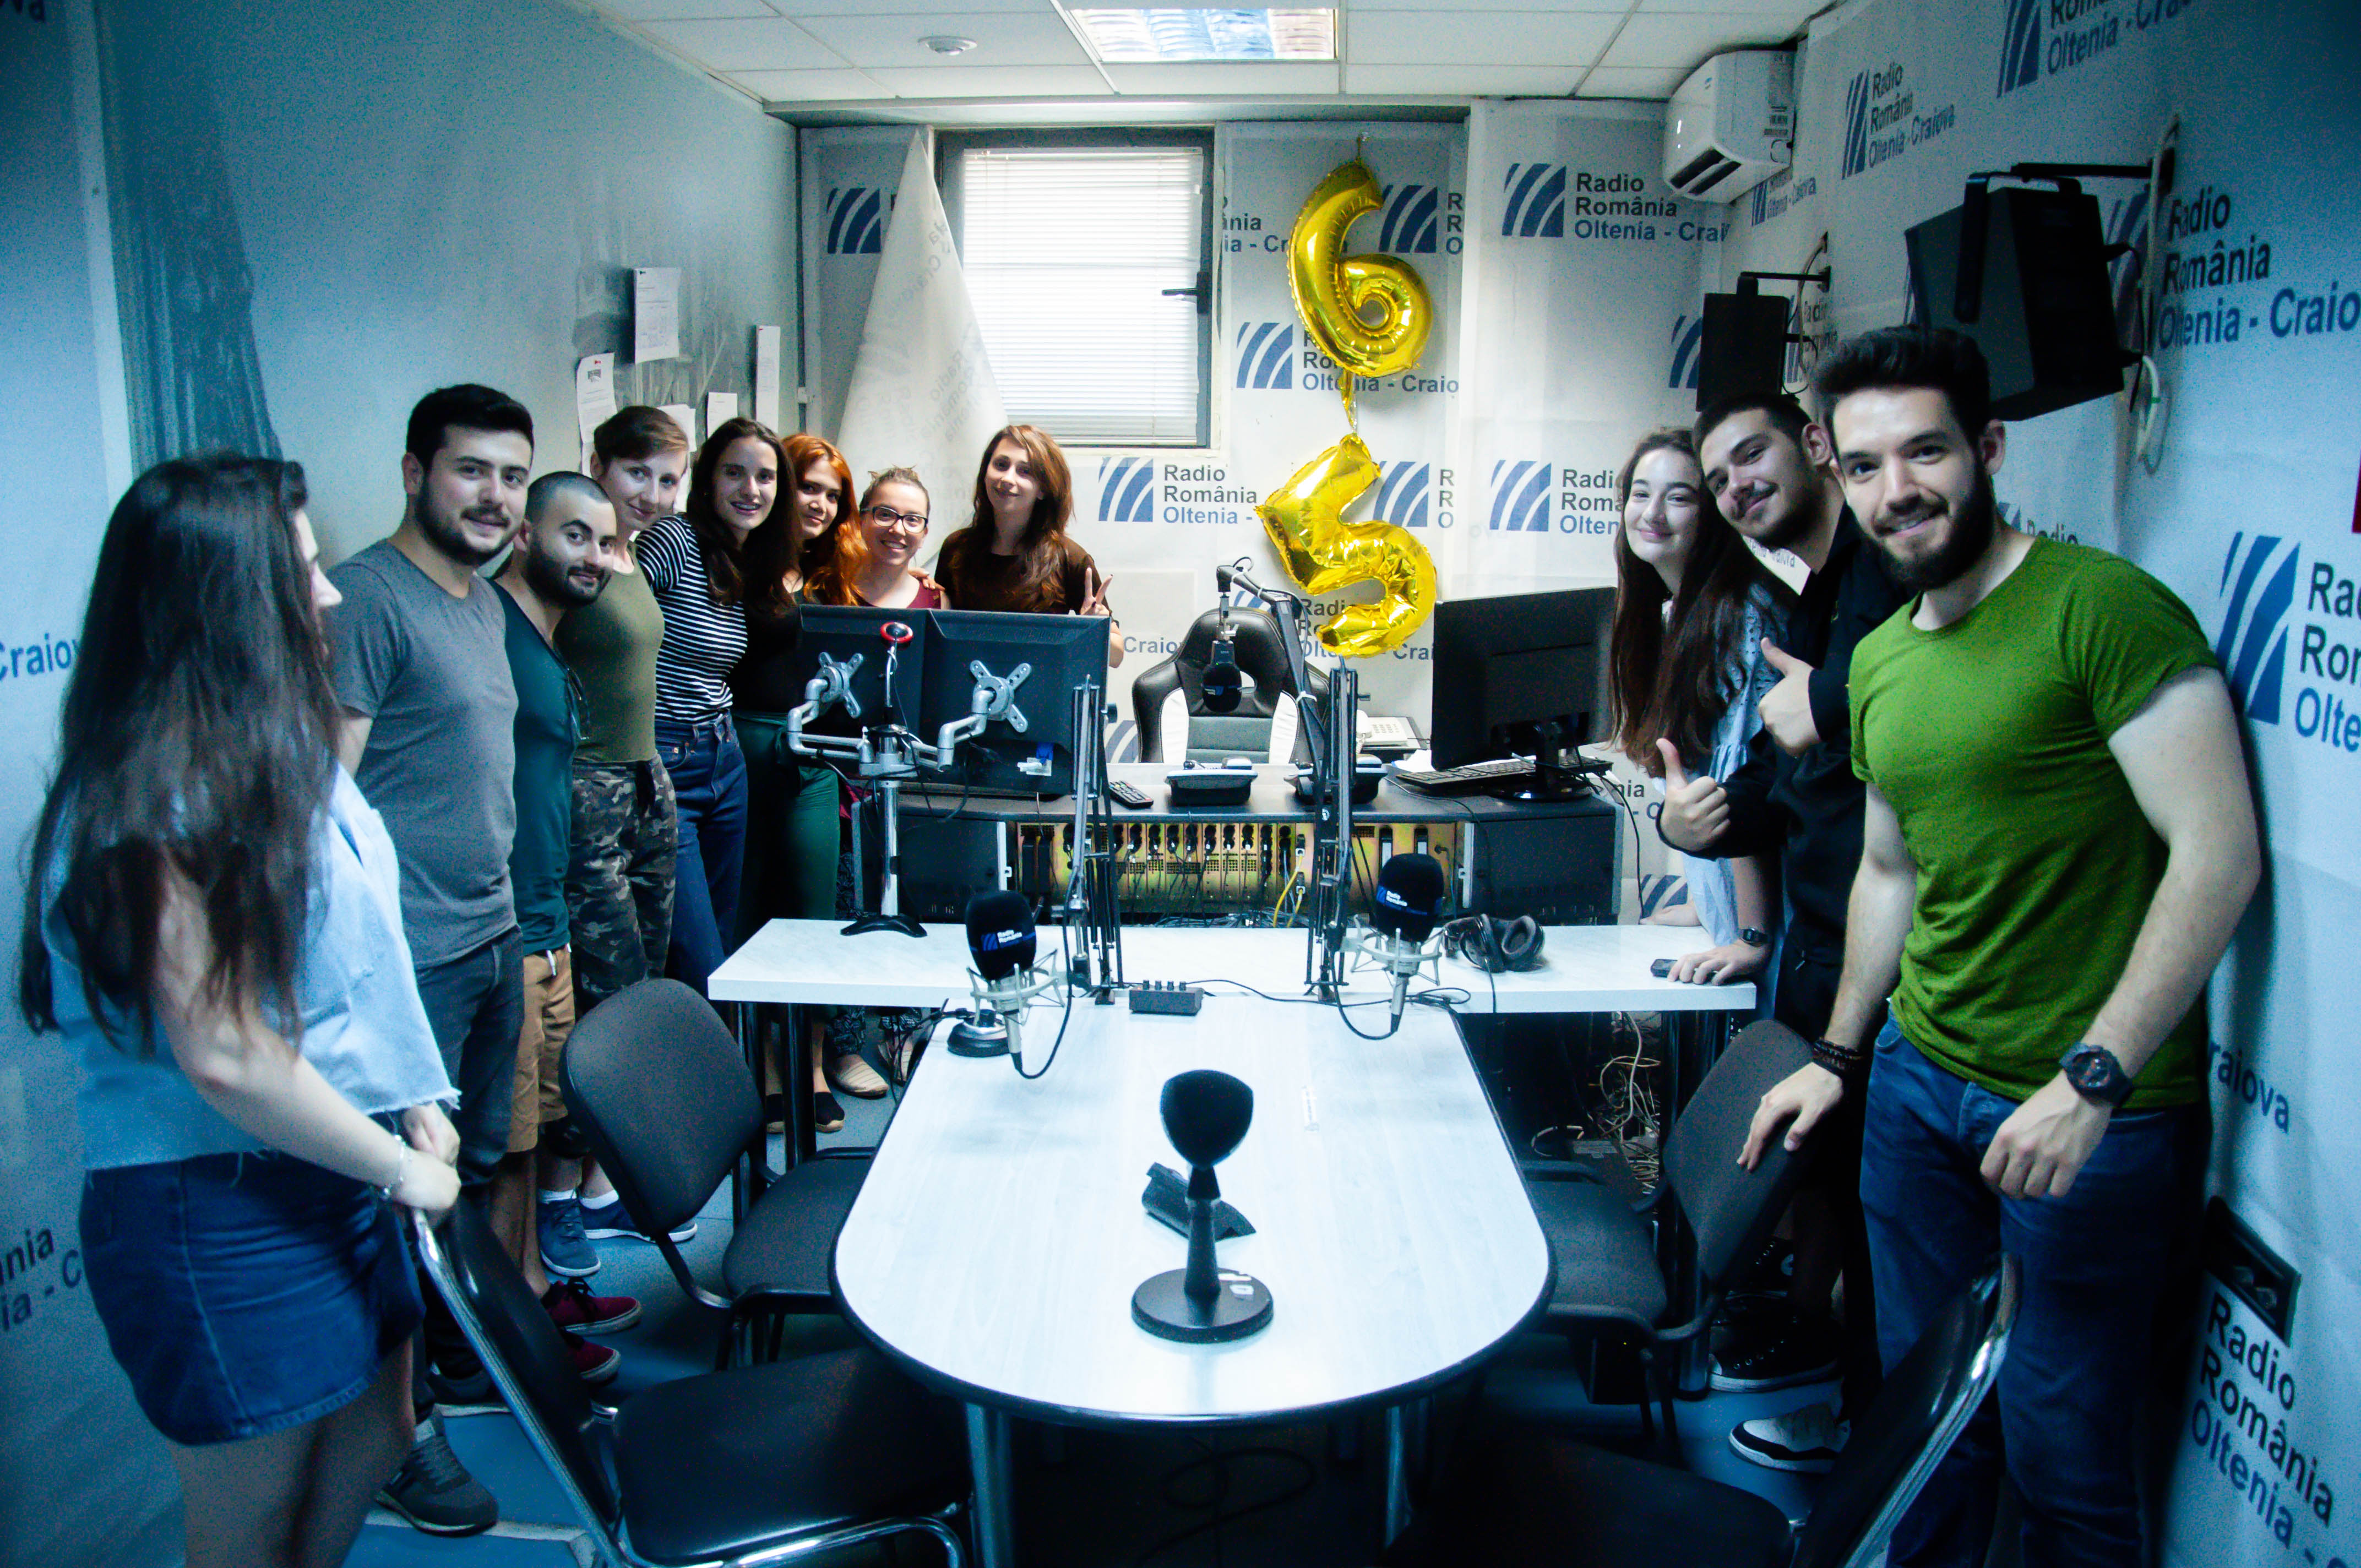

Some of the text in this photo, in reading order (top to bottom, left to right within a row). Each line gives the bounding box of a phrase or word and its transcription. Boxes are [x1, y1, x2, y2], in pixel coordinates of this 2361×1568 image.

[2048, 11, 2118, 75] Oltenia
[1576, 172, 1644, 193] Radio
[1575, 196, 1678, 217] România
[1575, 220, 1655, 241] Oltenia
[1164, 464, 1226, 482] Radio
[1164, 485, 1258, 503] România
[1163, 507, 1238, 524] Oltenia
[2207, 1291, 2295, 1412] Radio
[2200, 1342, 2333, 1529] România
[2192, 1398, 2293, 1550] Oltenia
